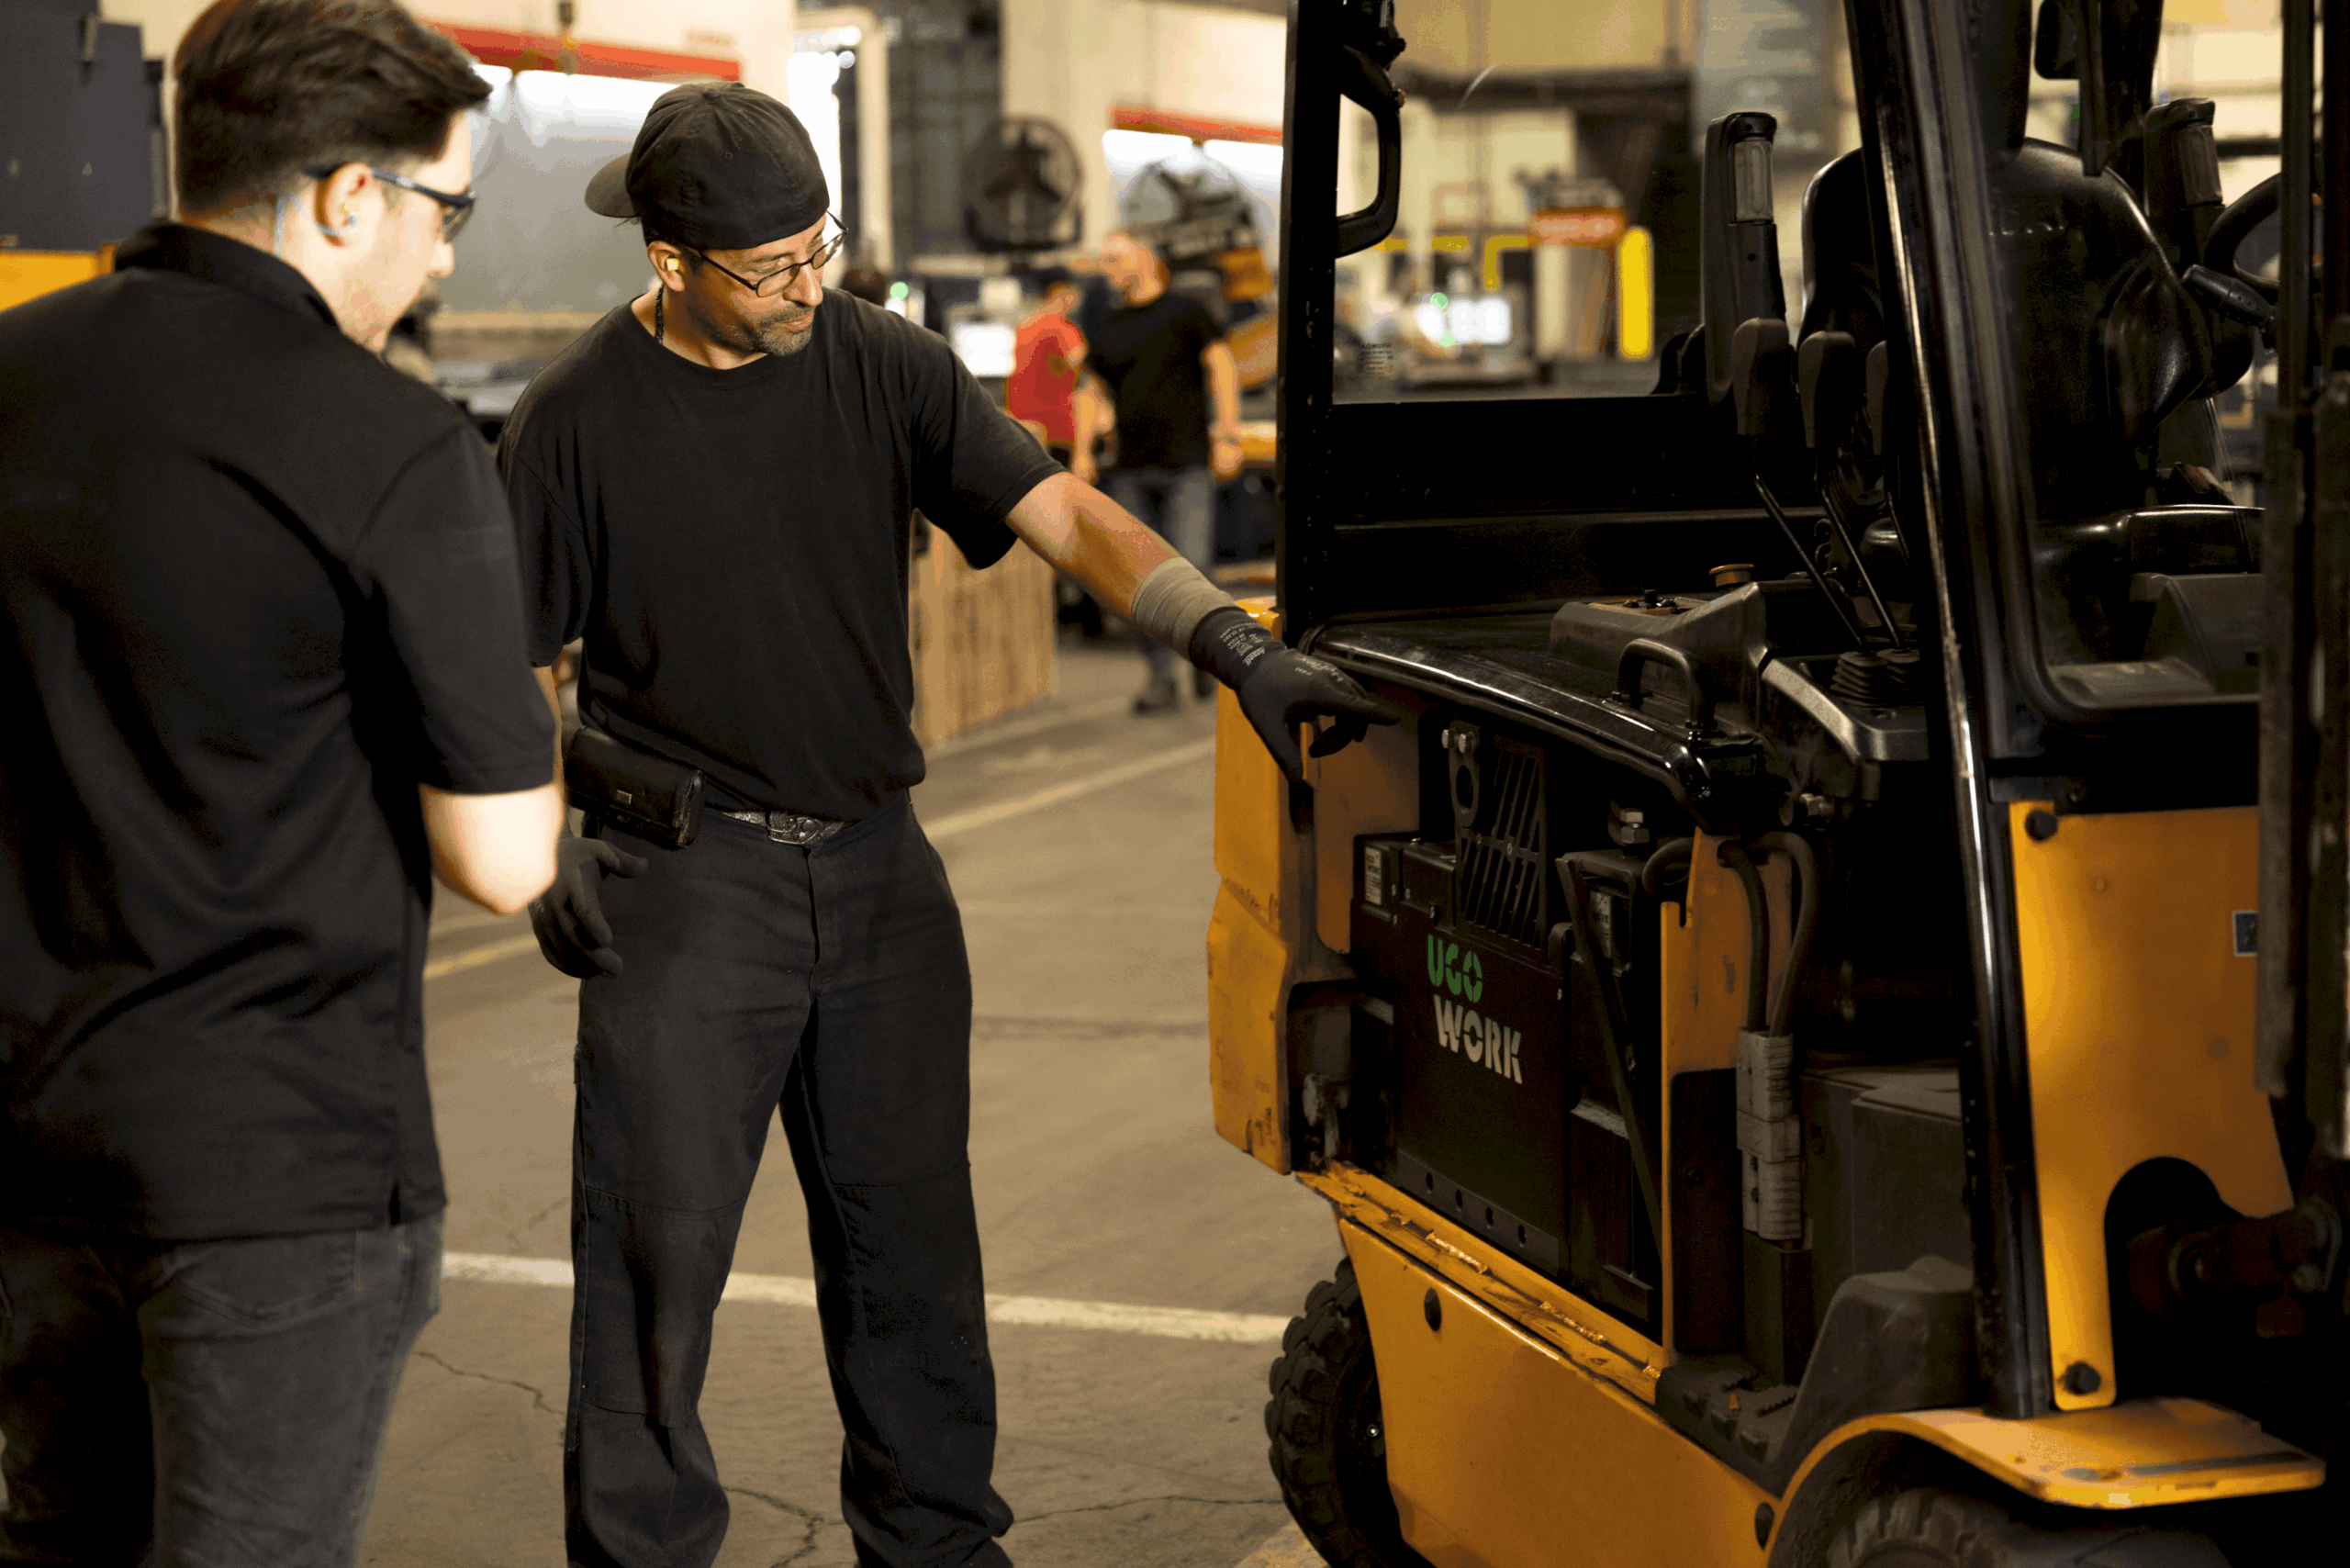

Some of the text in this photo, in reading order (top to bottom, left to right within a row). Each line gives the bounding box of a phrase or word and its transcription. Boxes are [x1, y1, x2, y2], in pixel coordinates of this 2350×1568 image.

[1244, 646, 1265, 666] Ansell
[1427, 935, 1483, 1003] UGO
[1434, 994, 1523, 1084] WORK
